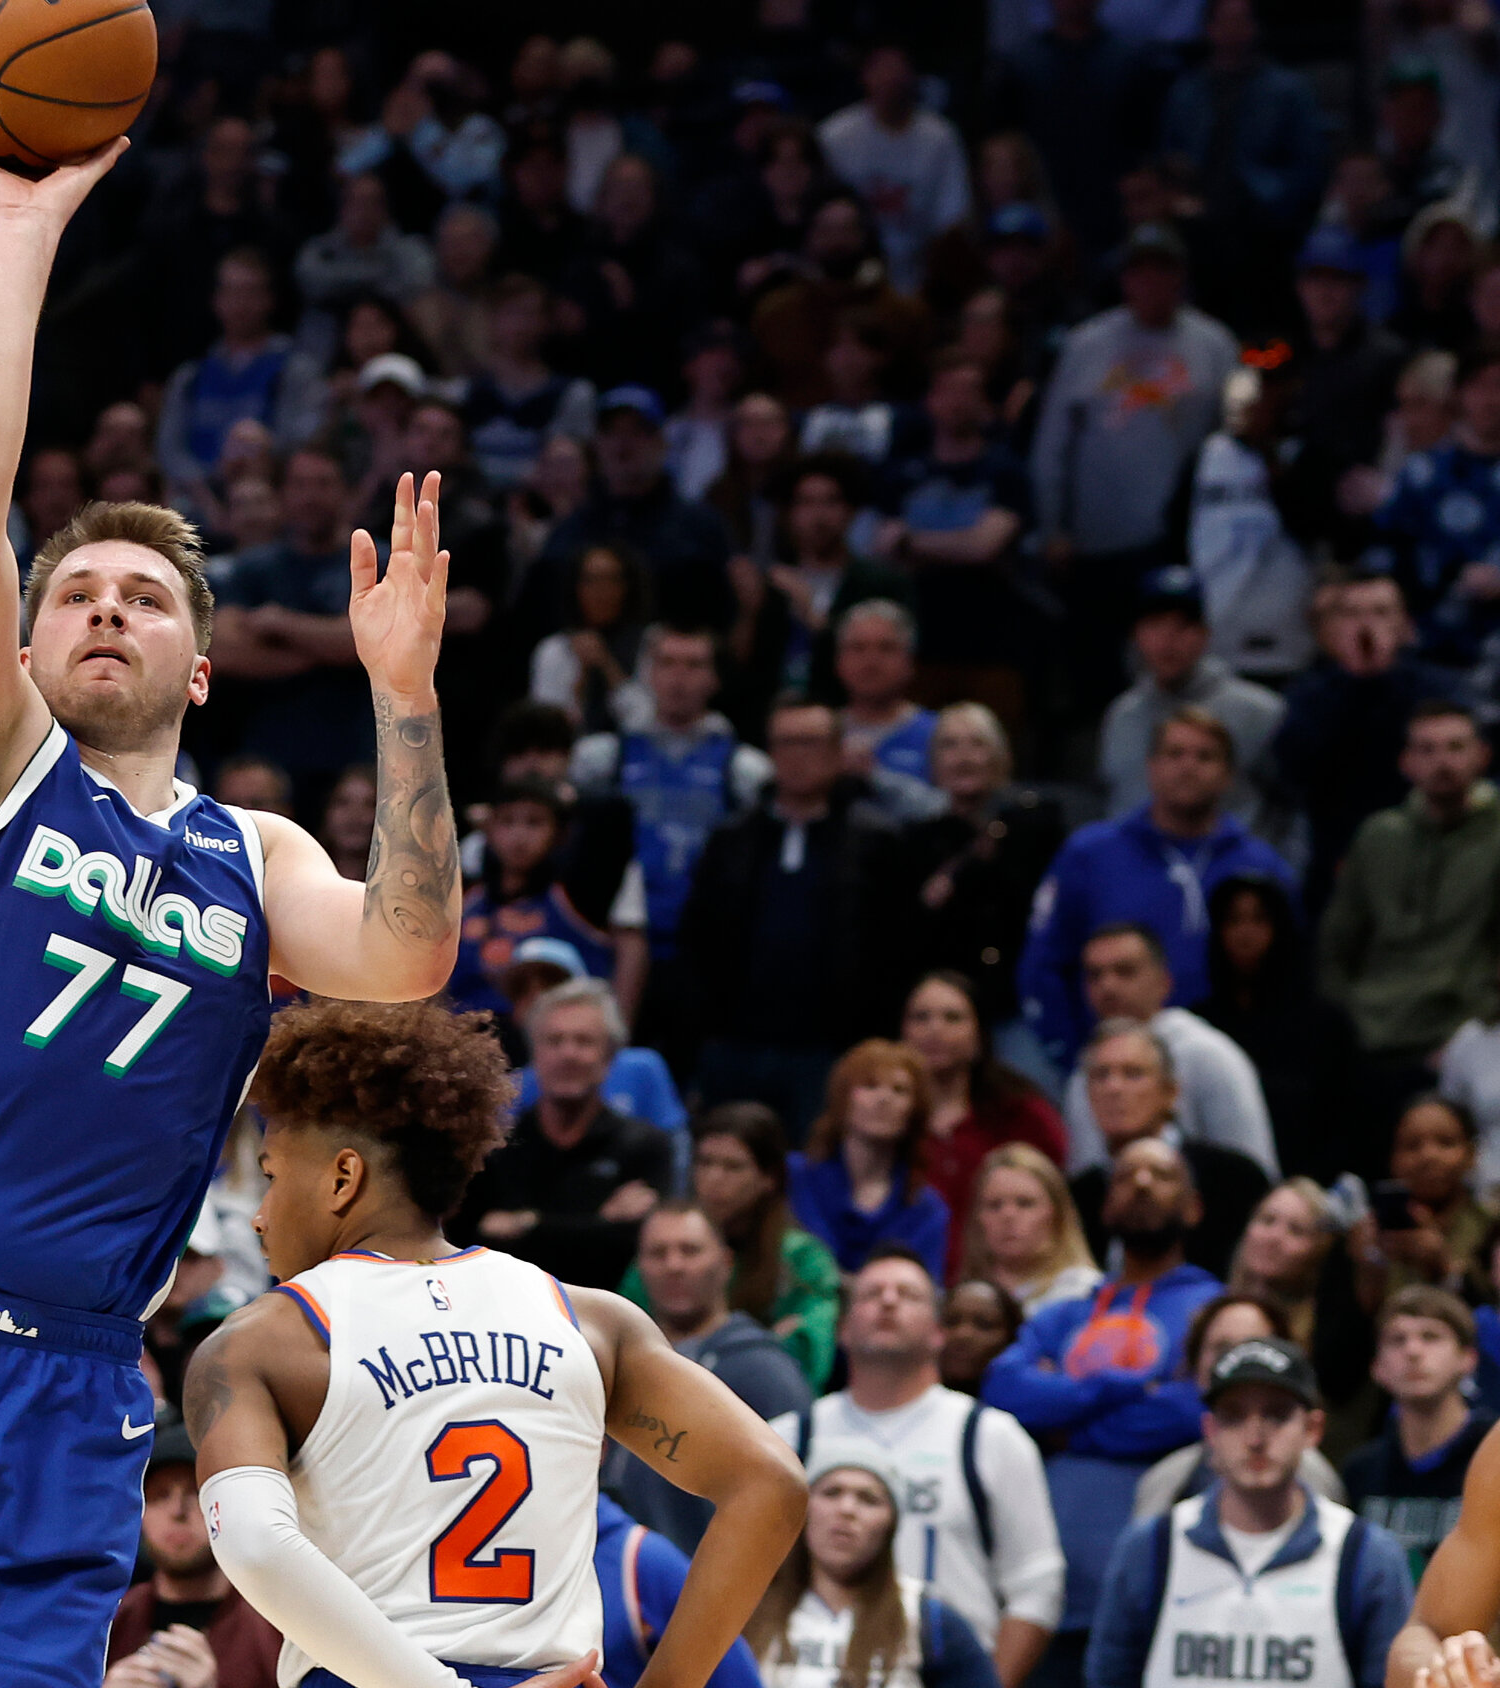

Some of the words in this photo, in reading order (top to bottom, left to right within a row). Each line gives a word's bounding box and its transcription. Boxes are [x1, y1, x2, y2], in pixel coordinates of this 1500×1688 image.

[183, 825, 240, 853] hime
[23, 933, 193, 1080] 77
[359, 1330, 564, 1410] McBRIDE
[425, 1419, 535, 1605] 2
[1174, 1631, 1316, 1682] DALLAS
